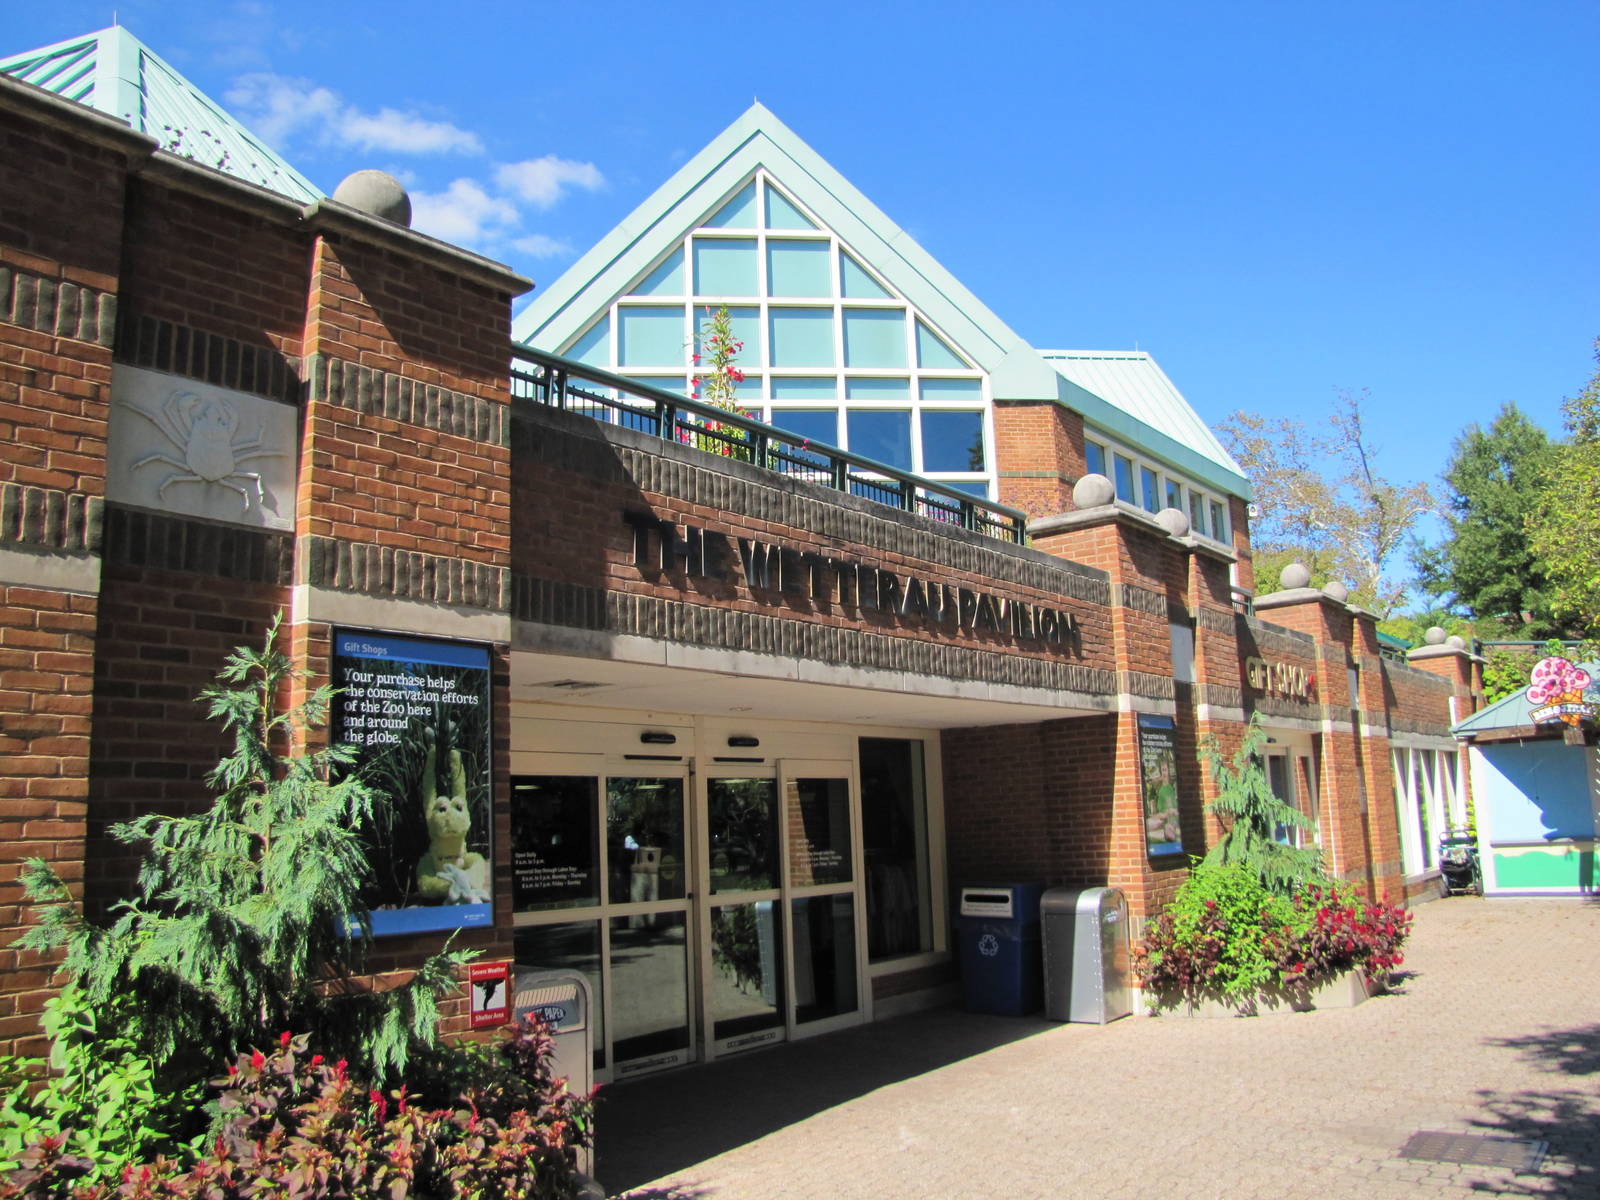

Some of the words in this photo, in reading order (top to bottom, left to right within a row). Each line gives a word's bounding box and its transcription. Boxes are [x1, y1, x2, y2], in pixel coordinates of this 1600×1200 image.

[625, 511, 731, 578] THE
[956, 586, 1079, 647] PAVILION
[344, 642, 360, 653] Gift
[361, 644, 388, 656] Shops
[344, 667, 373, 683] Your
[376, 672, 425, 687] purchase
[427, 675, 456, 692] helps
[1245, 656, 1275, 692] GIFT
[344, 684, 364, 697] the
[367, 688, 439, 702] conservation
[441, 692, 479, 707] efforts
[344, 700, 357, 712] of
[360, 700, 380, 713] the
[382, 700, 405, 714] Zoo
[407, 703, 432, 716] here
[344, 714, 365, 727] and
[367, 717, 408, 729] around
[344, 729, 364, 742] the
[366, 730, 401, 745] globe.
[545, 1007, 564, 1020] PAPER
